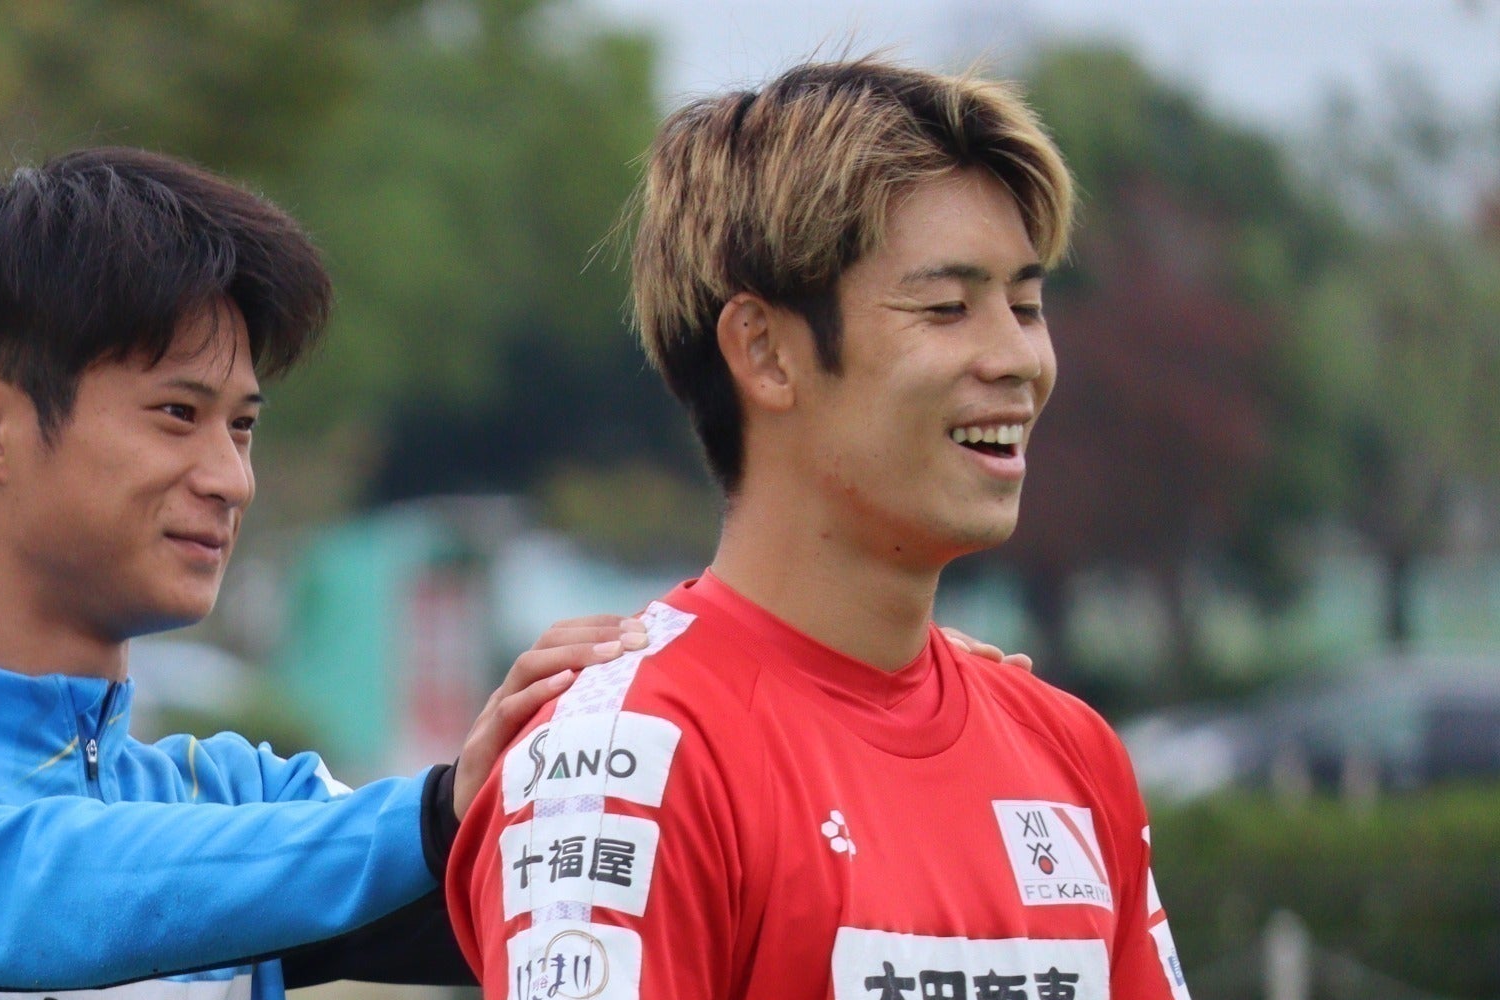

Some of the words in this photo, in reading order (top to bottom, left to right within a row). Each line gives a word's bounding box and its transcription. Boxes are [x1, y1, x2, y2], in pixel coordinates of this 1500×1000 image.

[524, 728, 637, 798] SANO
[512, 835, 636, 889] 十福屋
[1024, 884, 1052, 900] FC
